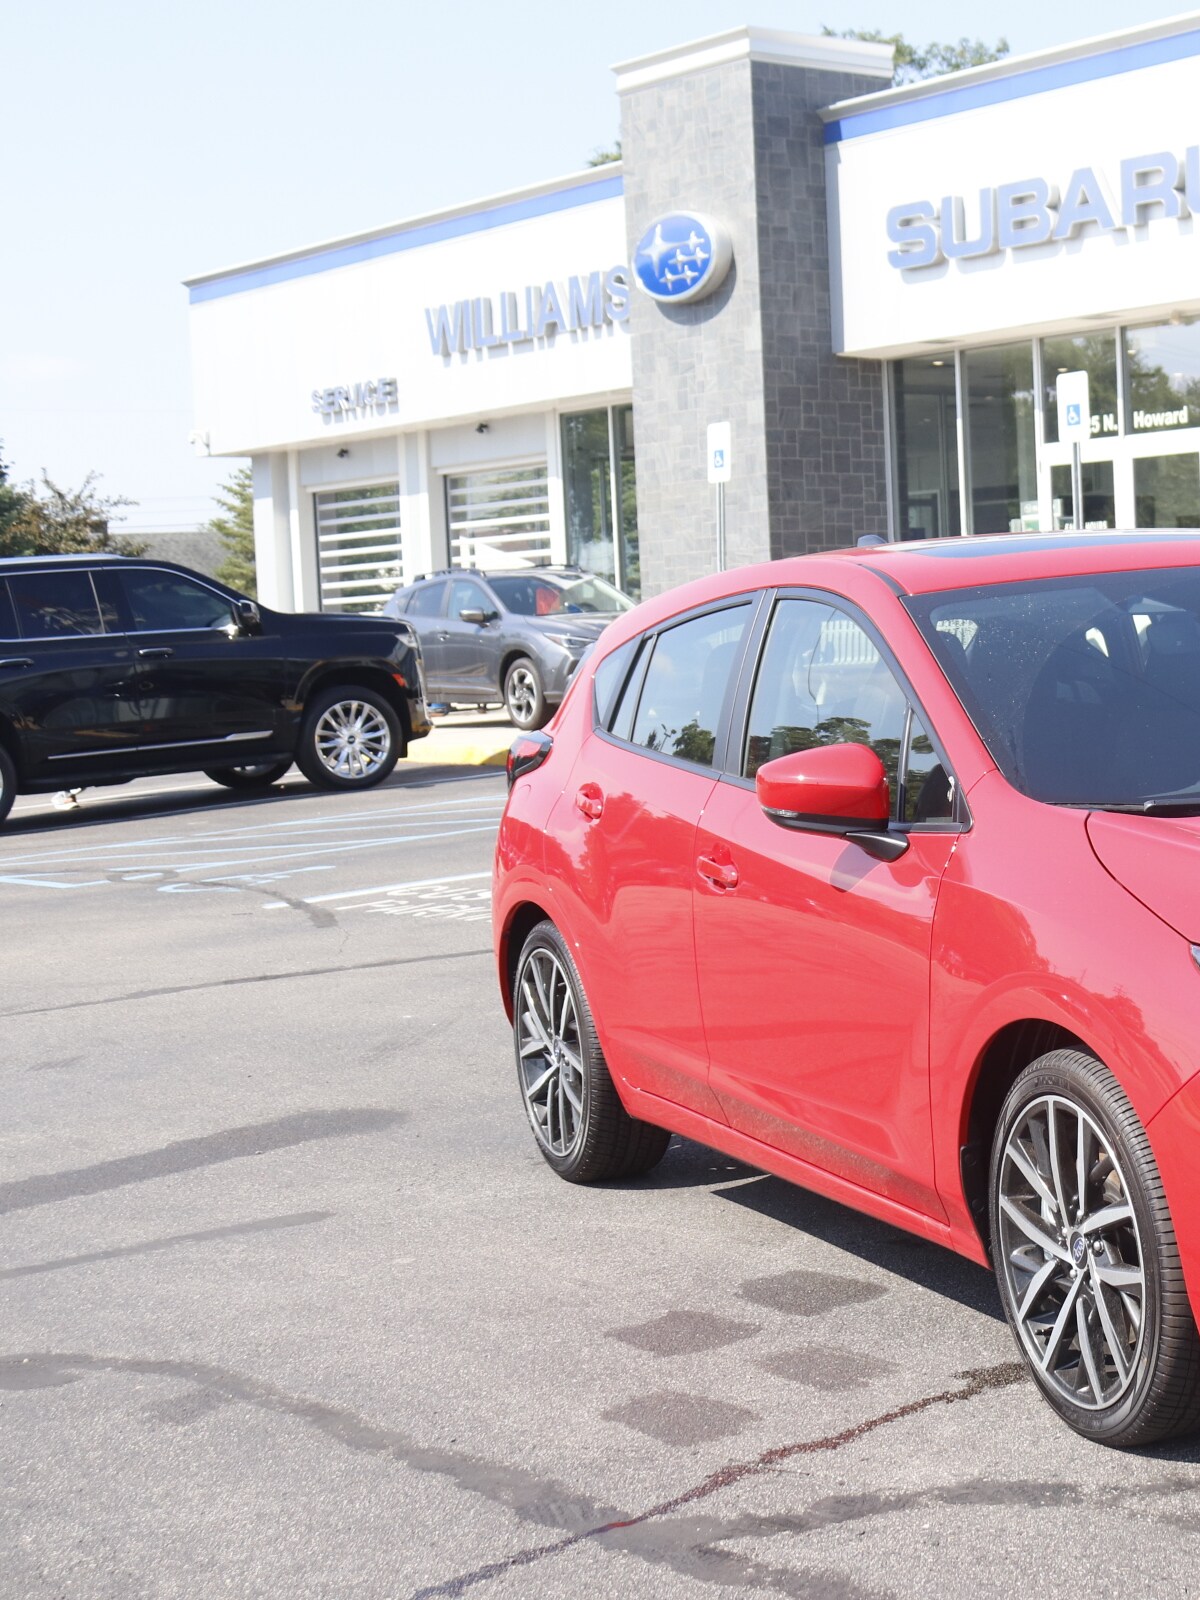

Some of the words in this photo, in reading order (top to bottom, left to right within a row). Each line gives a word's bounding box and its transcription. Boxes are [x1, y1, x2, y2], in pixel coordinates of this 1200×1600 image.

[424, 264, 630, 357] WILLIAMS
[312, 377, 398, 414] SERVICE
[1133, 405, 1189, 429] Howard
